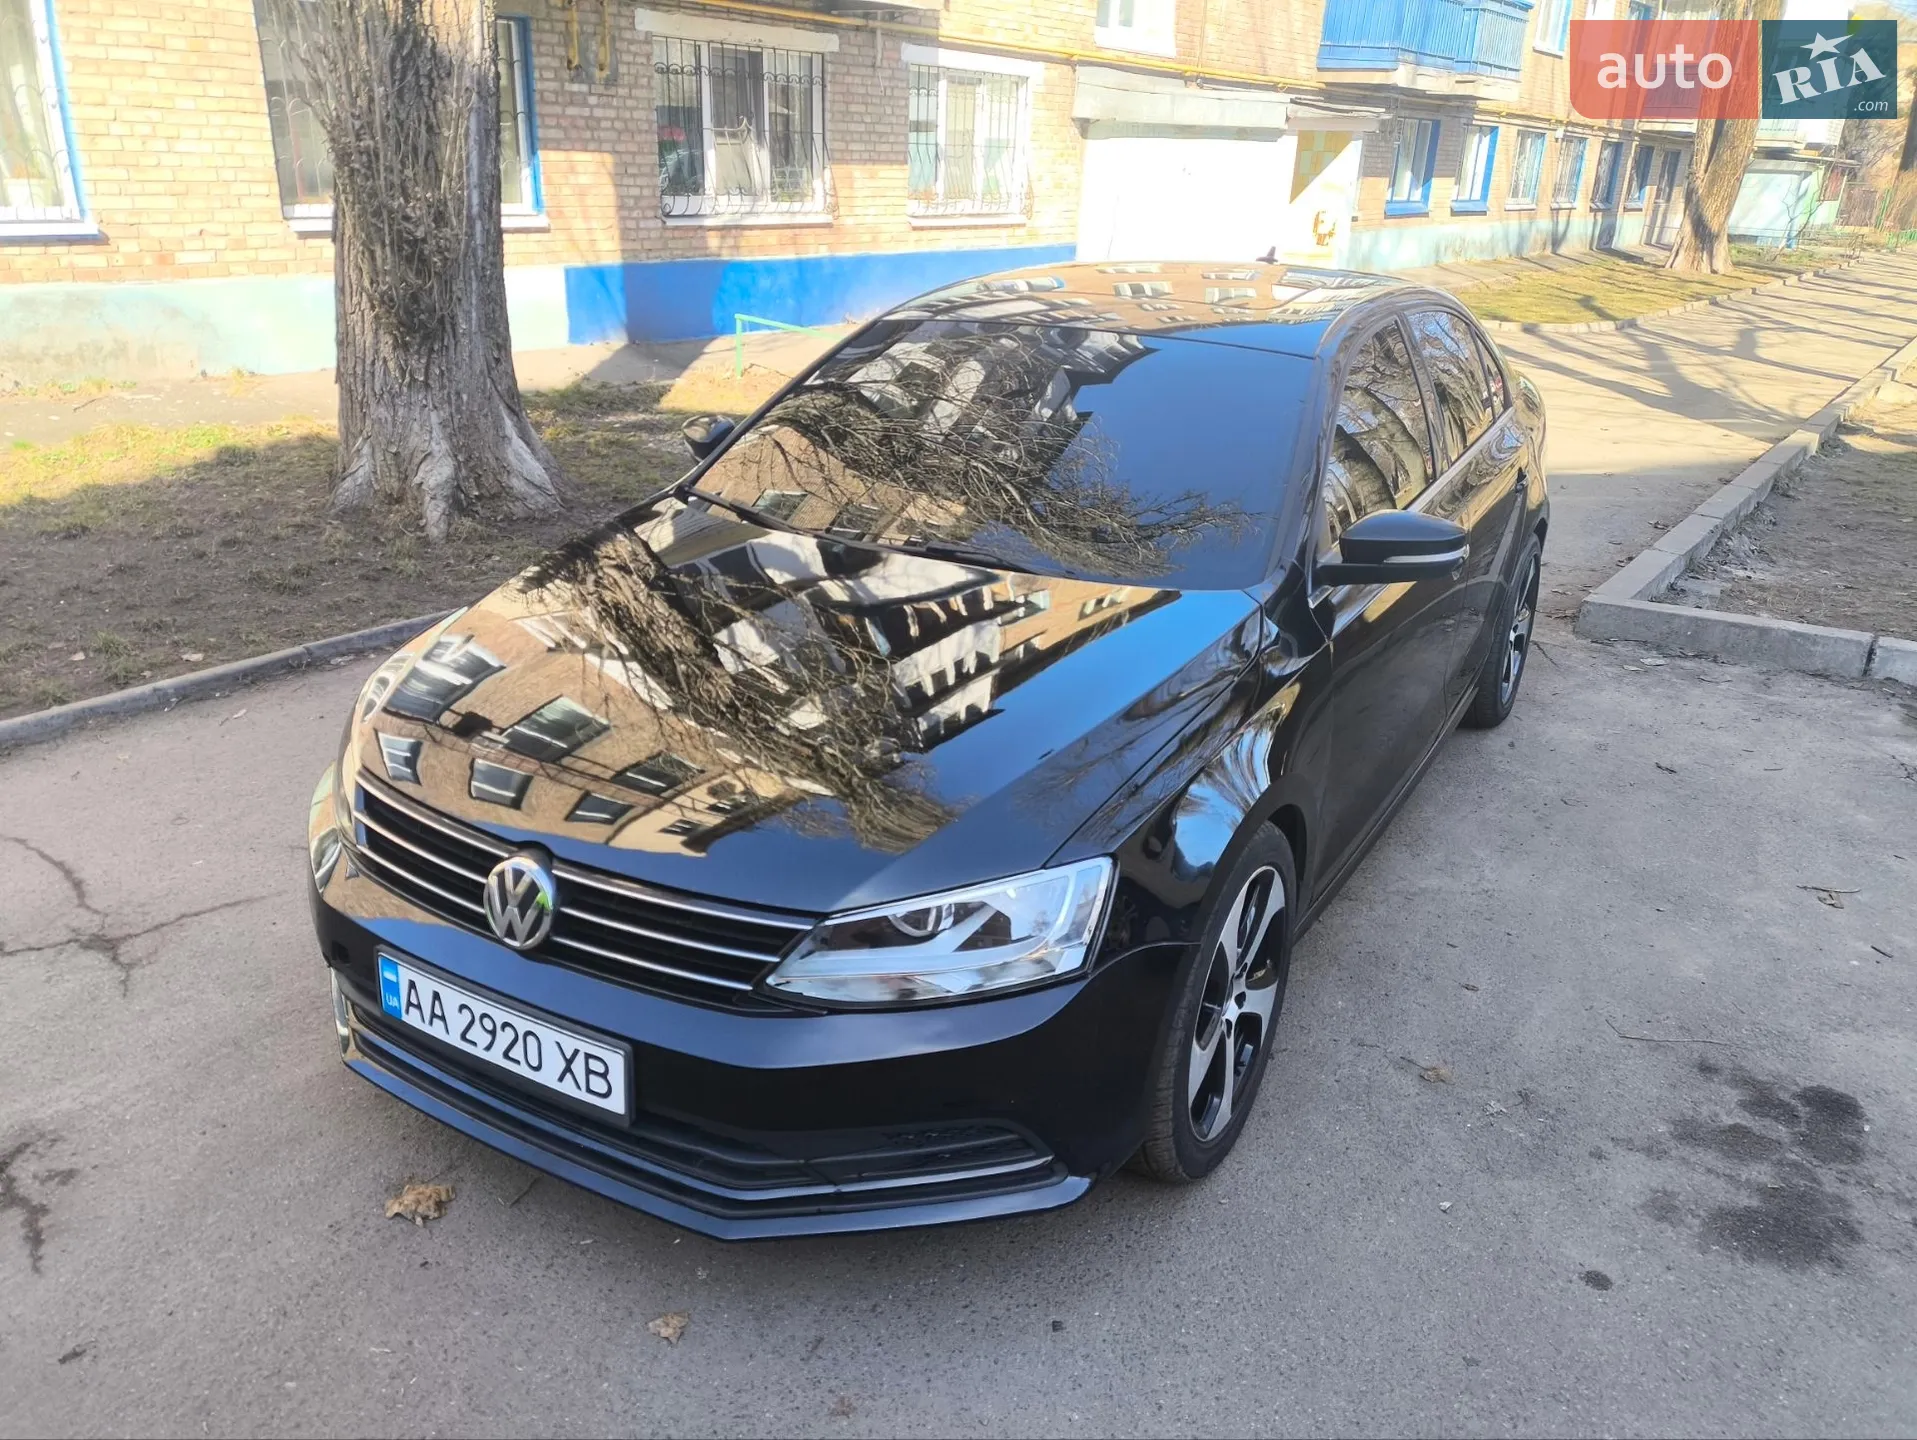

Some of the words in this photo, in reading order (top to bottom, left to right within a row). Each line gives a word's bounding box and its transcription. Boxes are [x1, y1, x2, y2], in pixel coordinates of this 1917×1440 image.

[385, 994, 400, 1009] UA
[404, 979, 450, 1035] AA
[457, 1003, 543, 1073] 2920
[555, 1040, 613, 1099] XB
